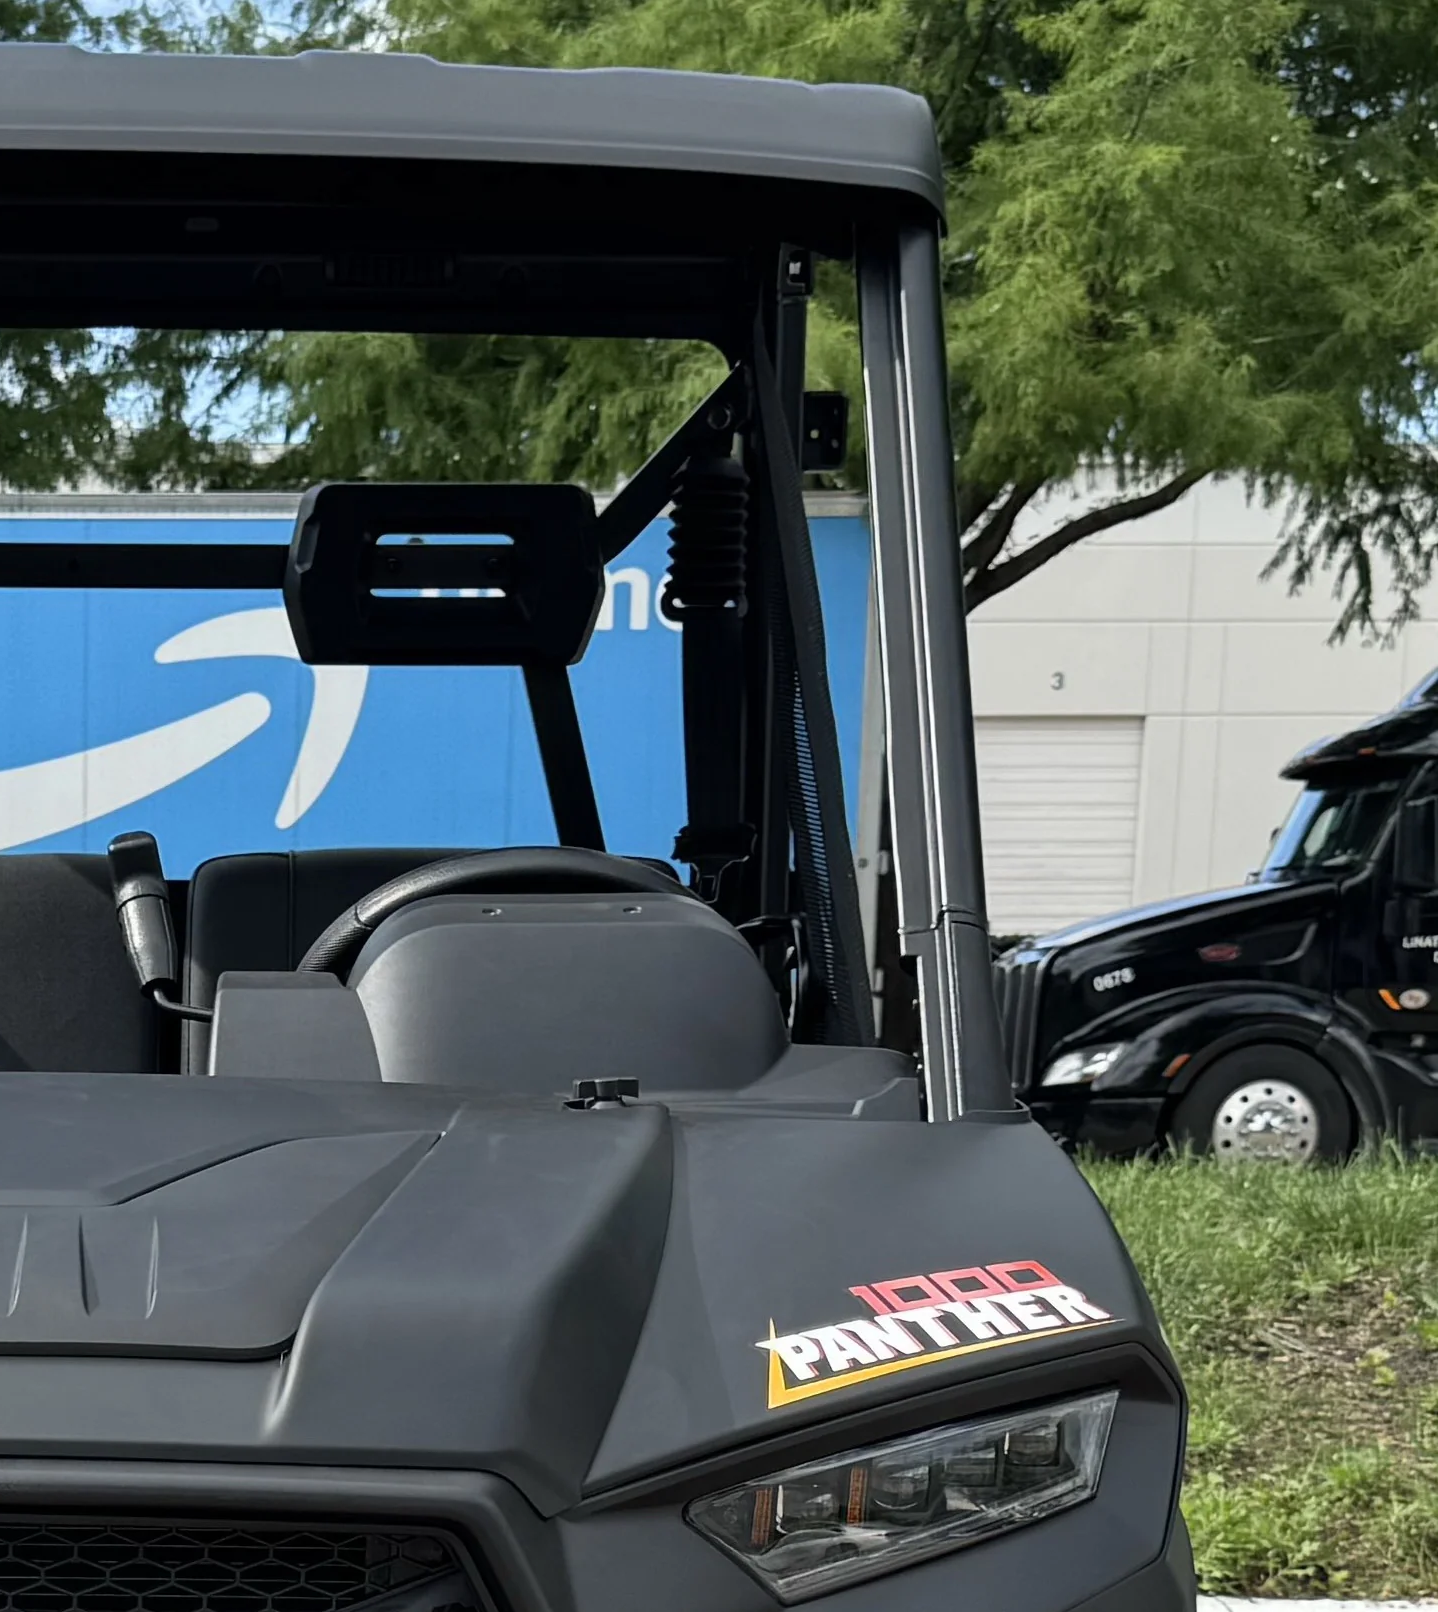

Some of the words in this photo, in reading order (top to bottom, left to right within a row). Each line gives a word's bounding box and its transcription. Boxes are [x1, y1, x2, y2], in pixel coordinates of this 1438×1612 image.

[1050, 671, 1065, 690] 3
[849, 1260, 1064, 1315] 1000
[756, 1284, 1112, 1381] PANTHER
